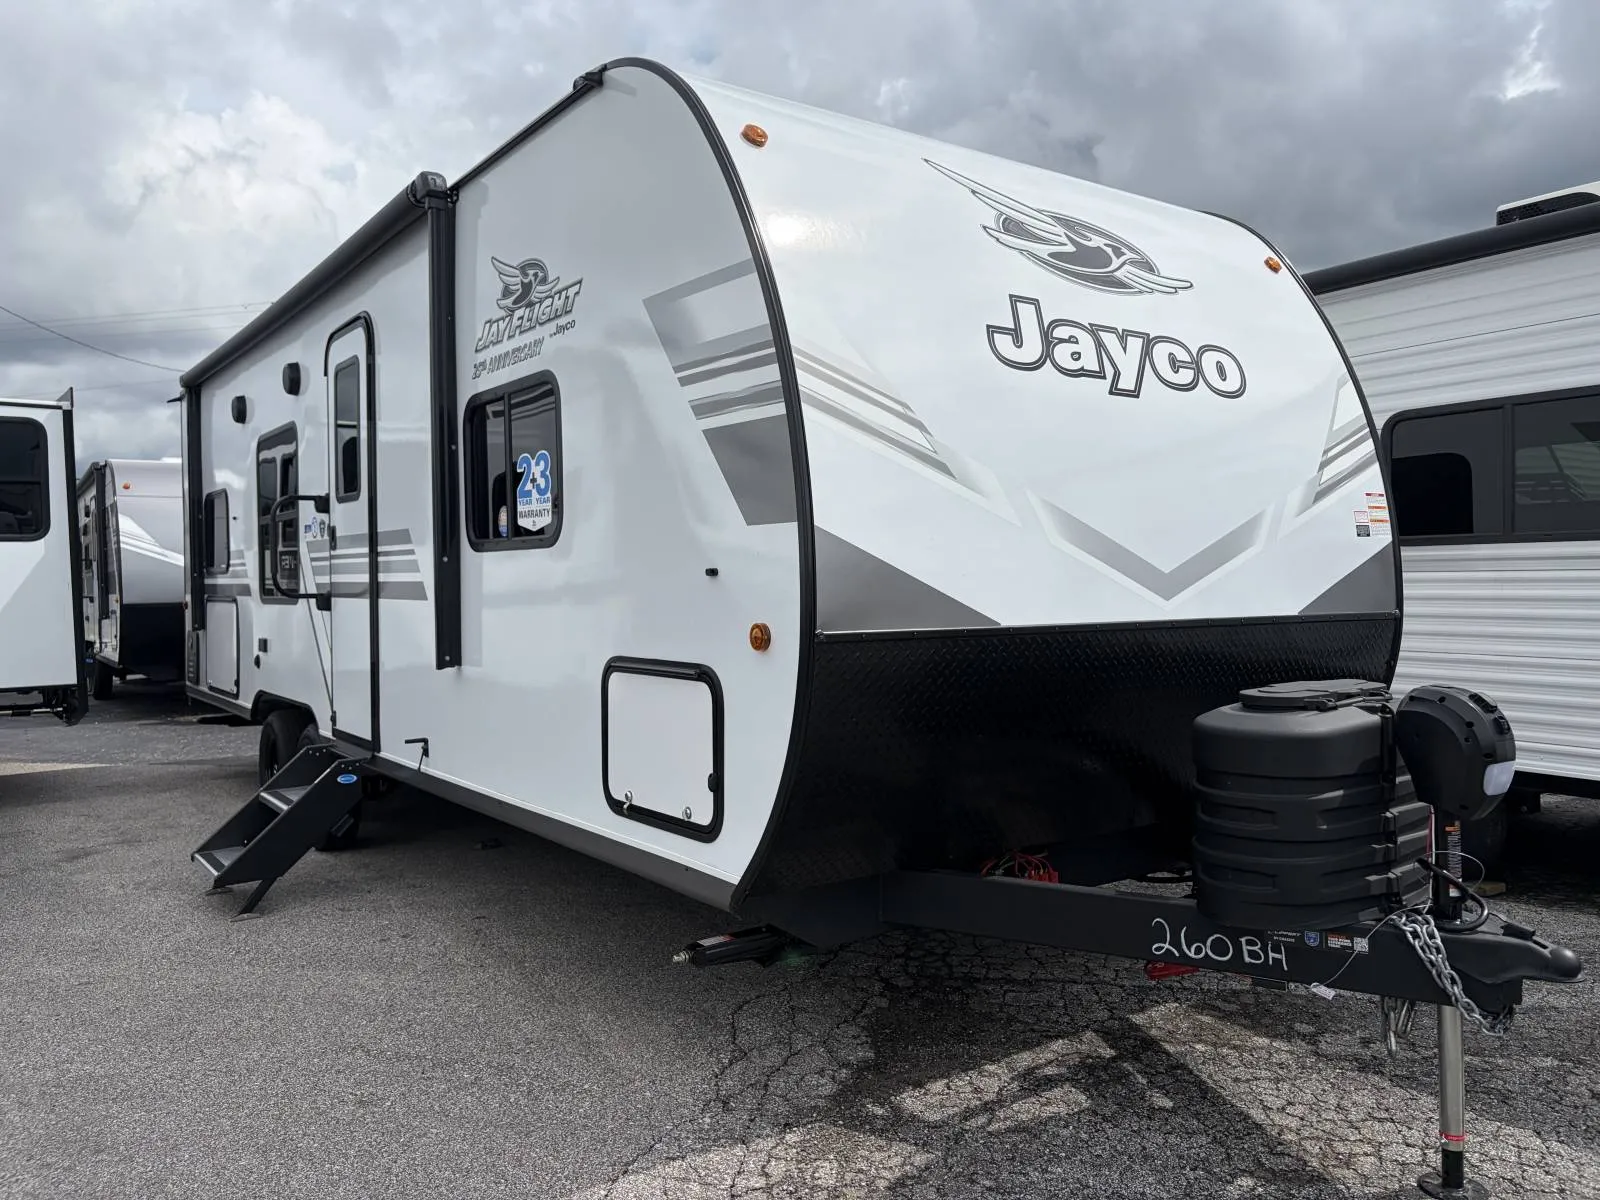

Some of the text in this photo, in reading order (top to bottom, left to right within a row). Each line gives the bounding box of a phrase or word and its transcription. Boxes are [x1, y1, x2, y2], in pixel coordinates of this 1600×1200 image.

[475, 279, 583, 353] JAY FLIGHT
[486, 336, 545, 375] ANNIVERSARY
[986, 294, 1247, 399] Jayco
[518, 507, 551, 519] WARRANTY
[519, 497, 551, 506] YEAR YEAR
